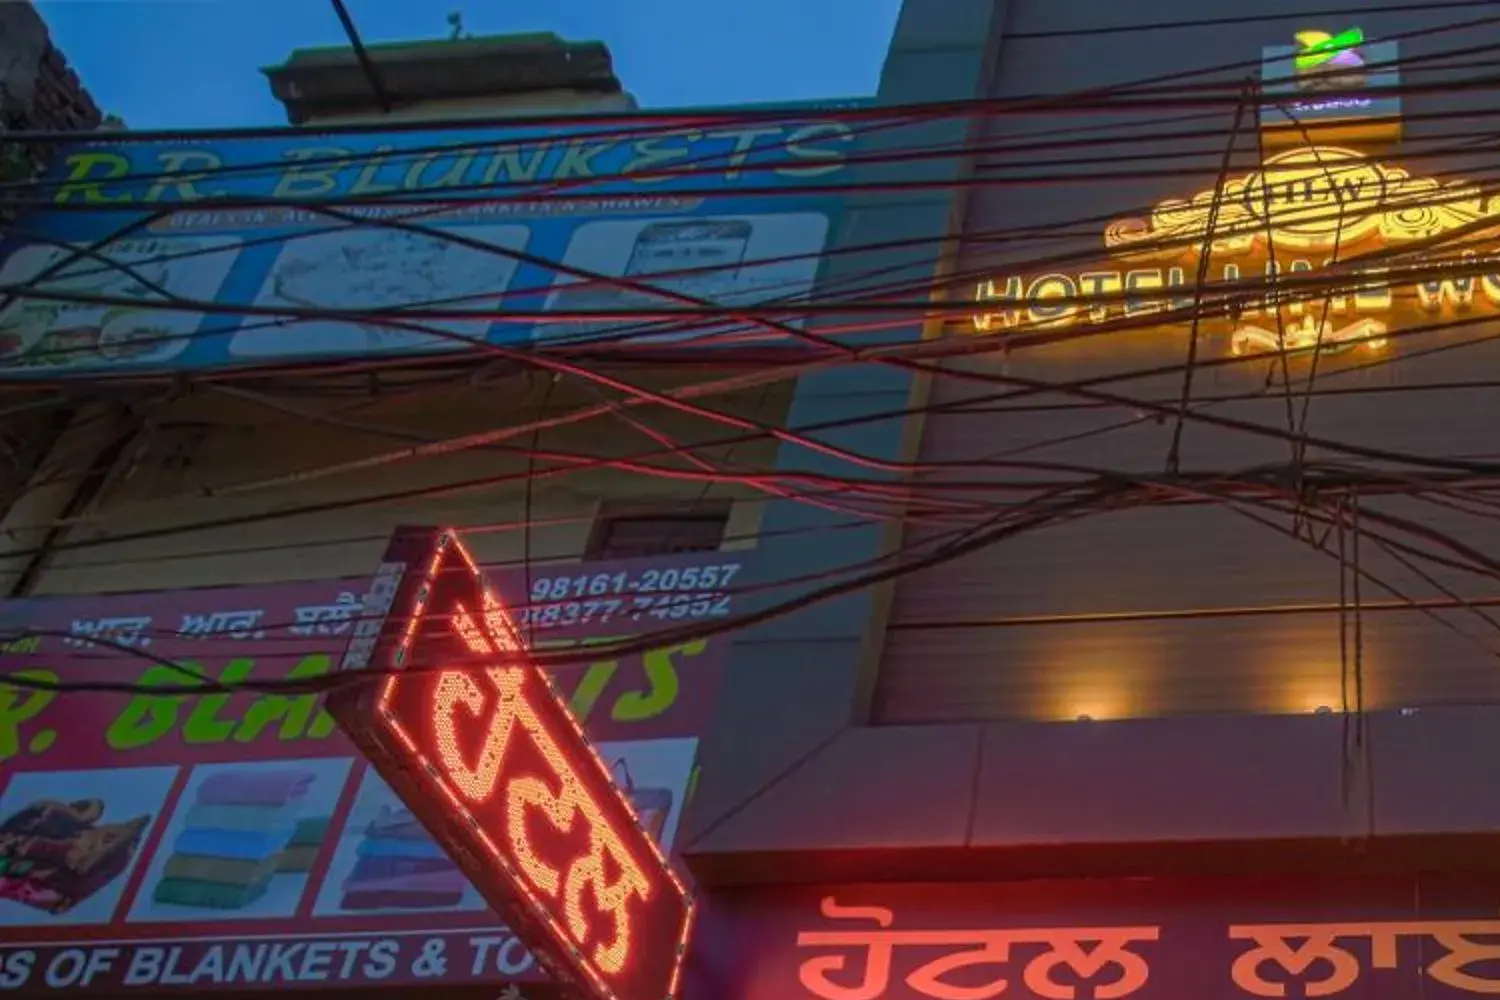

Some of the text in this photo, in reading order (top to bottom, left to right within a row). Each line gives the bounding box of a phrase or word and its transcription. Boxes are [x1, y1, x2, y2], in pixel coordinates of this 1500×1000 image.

[530, 563, 742, 602] 98161-20557
[44, 947, 119, 988] OF
[122, 939, 397, 986] BLANKETS
[411, 937, 448, 978] &
